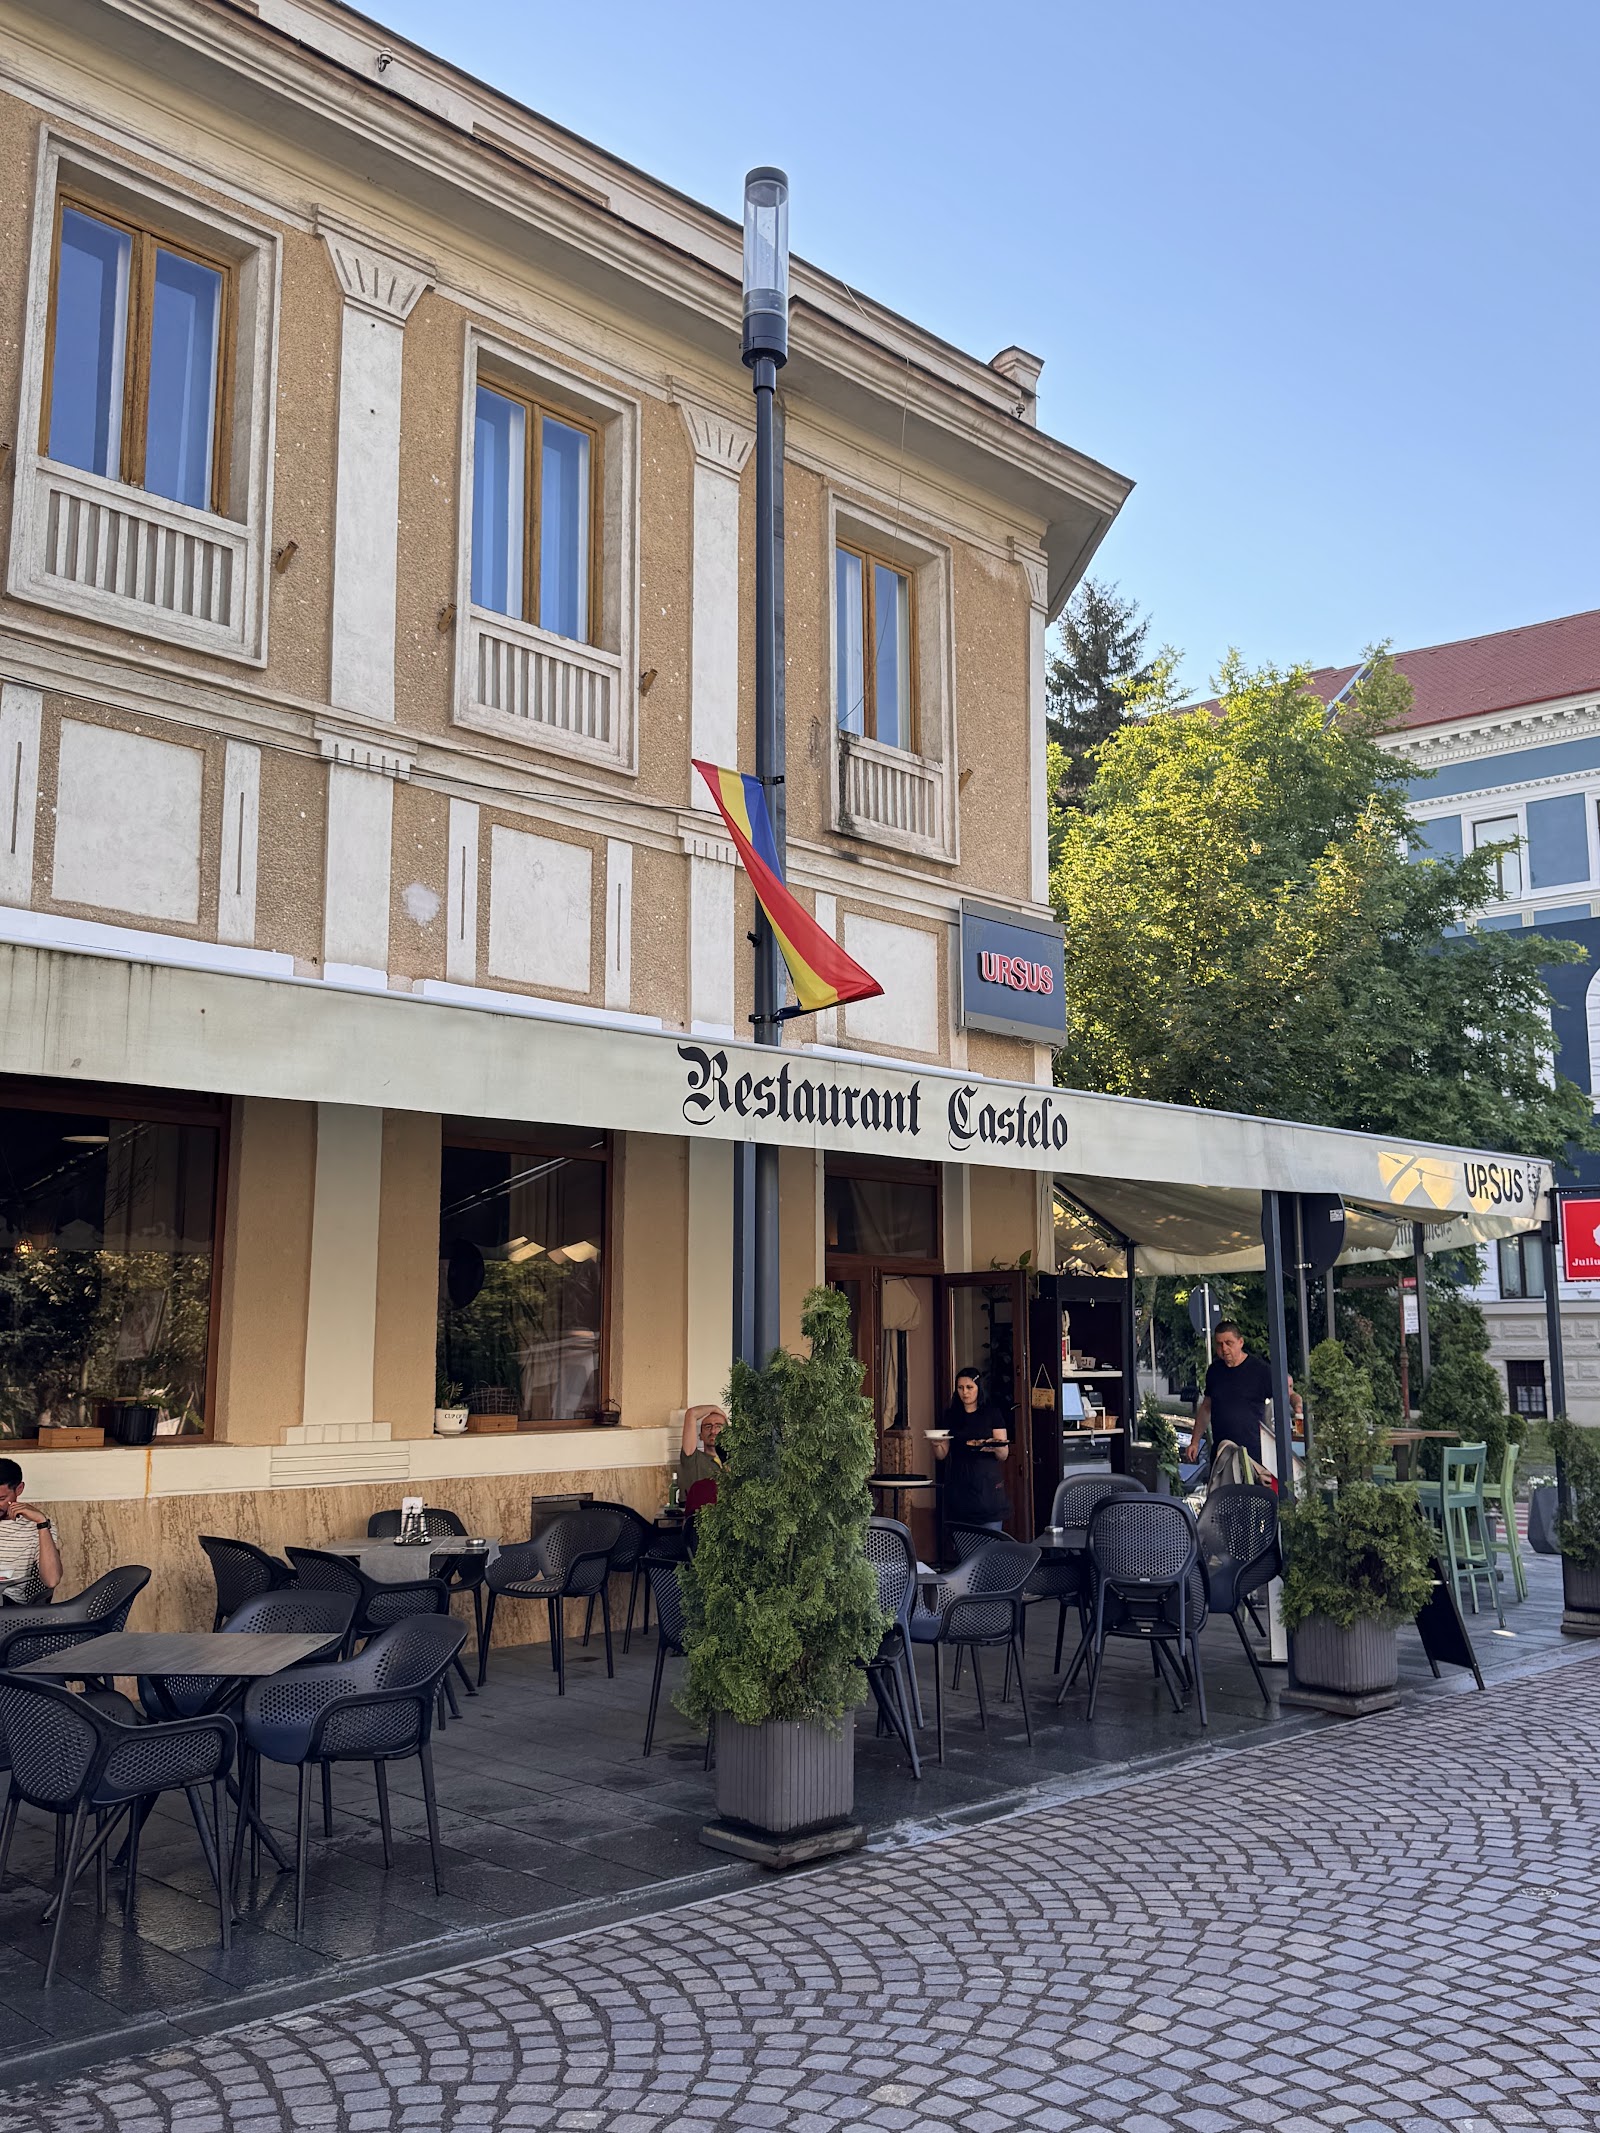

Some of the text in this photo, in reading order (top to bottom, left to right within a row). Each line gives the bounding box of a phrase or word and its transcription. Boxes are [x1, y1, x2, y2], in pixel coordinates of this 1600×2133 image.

[980, 950, 1054, 994] URSUS
[677, 1042, 1068, 1151] Restaurant Castelo
[1463, 1162, 1524, 1205] URSUS
